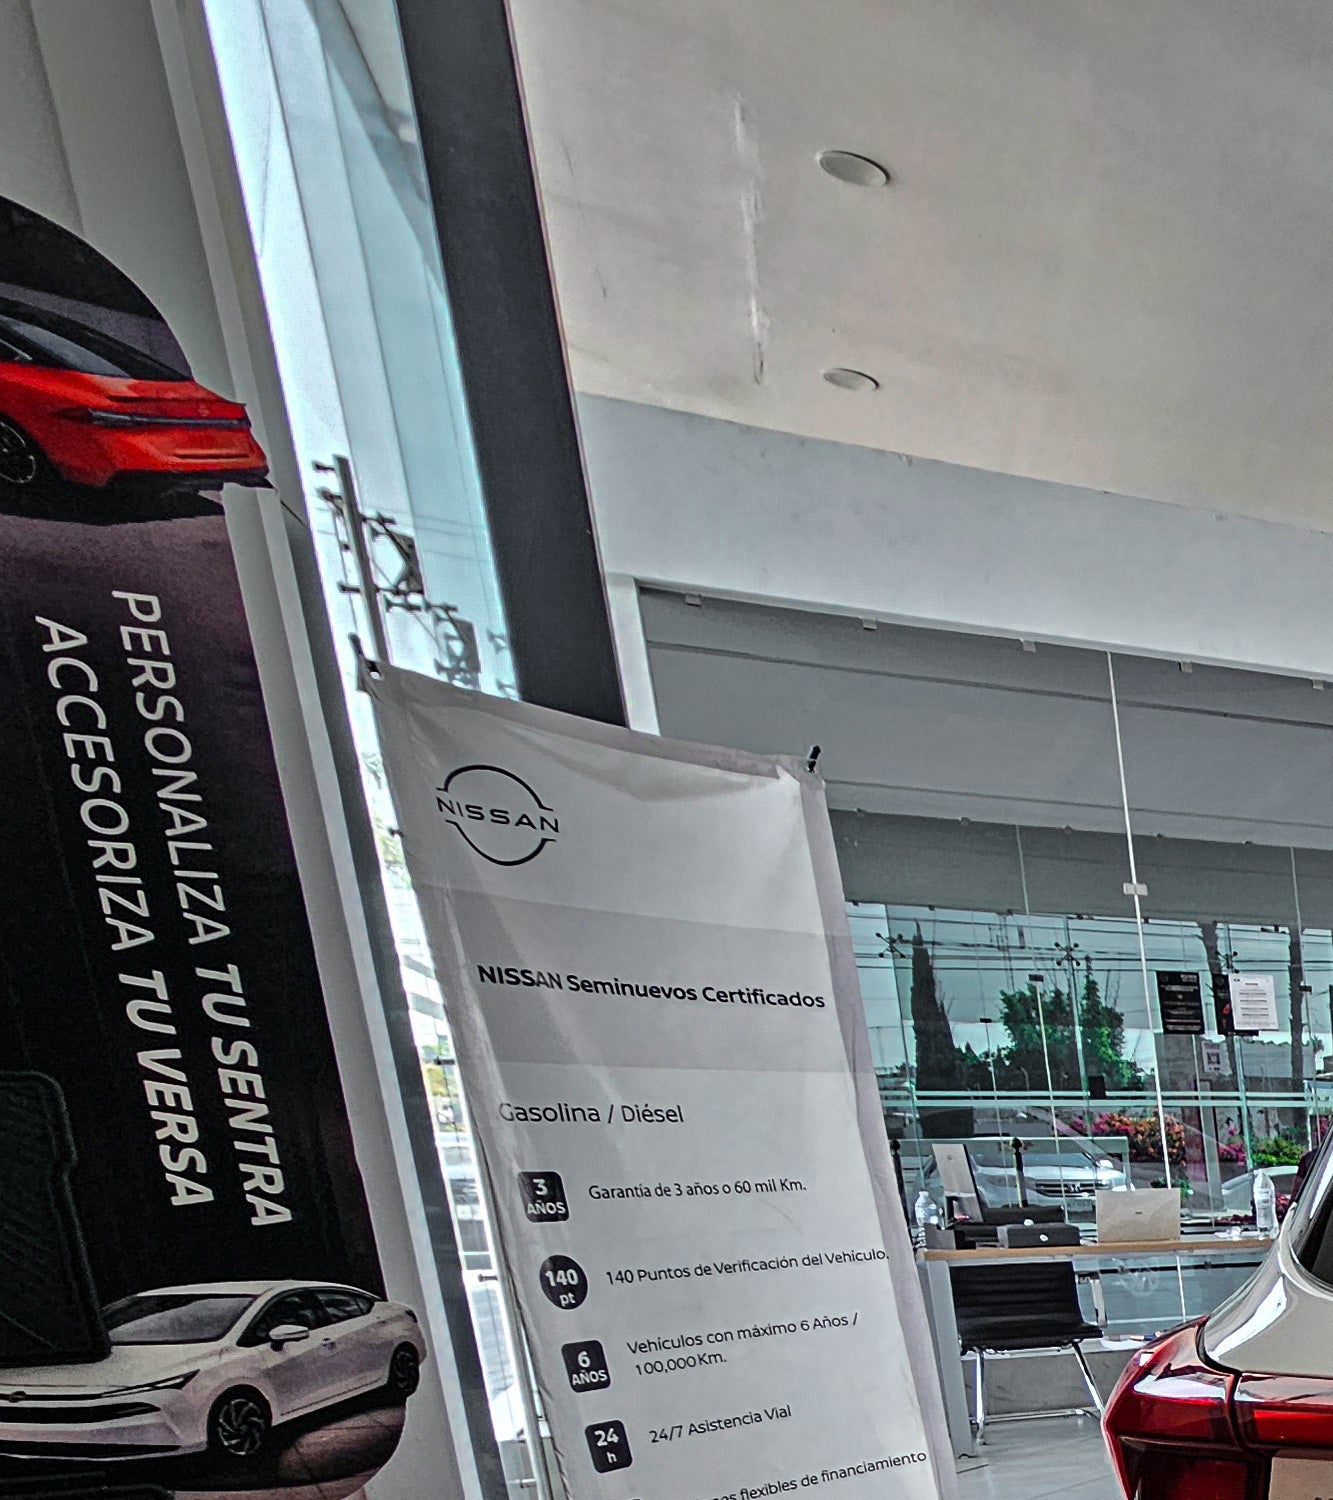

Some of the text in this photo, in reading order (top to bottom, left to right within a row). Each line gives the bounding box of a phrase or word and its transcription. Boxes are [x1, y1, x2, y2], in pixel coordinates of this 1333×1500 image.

[436, 796, 559, 833] NISSAN
[34, 614, 215, 1207] ACCESORIZA TU VERSA
[111, 589, 293, 1228] PERSONALIZA TU SENTRA
[477, 965, 826, 1009] NISSAN Seminuevos Certificados
[500, 1103, 684, 1124] Gasolina / Diésel
[533, 1178, 548, 1196] 3
[588, 1178, 807, 1200] Garantía de 3 años o 60 mil Km.
[527, 1200, 566, 1216] AÑOS
[606, 1248, 890, 1285] 140 Puntos de Verificación del Vehículo.
[545, 1268, 579, 1287] 140
[559, 1292, 576, 1307] pt
[626, 1331, 703, 1355] Vehículos
[706, 1330, 734, 1345] con
[737, 1321, 797, 1340] máximo
[800, 1319, 810, 1332] 6
[812, 1315, 849, 1330] Años
[578, 1350, 591, 1368] 6
[571, 1368, 608, 1386] AÑOS
[649, 1405, 792, 1443] 24/7 Asistencia Vial
[594, 1428, 620, 1447] 24
[607, 1451, 617, 1464] h
[800, 1474, 818, 1488] de
[821, 1450, 928, 1482] financiamiento
